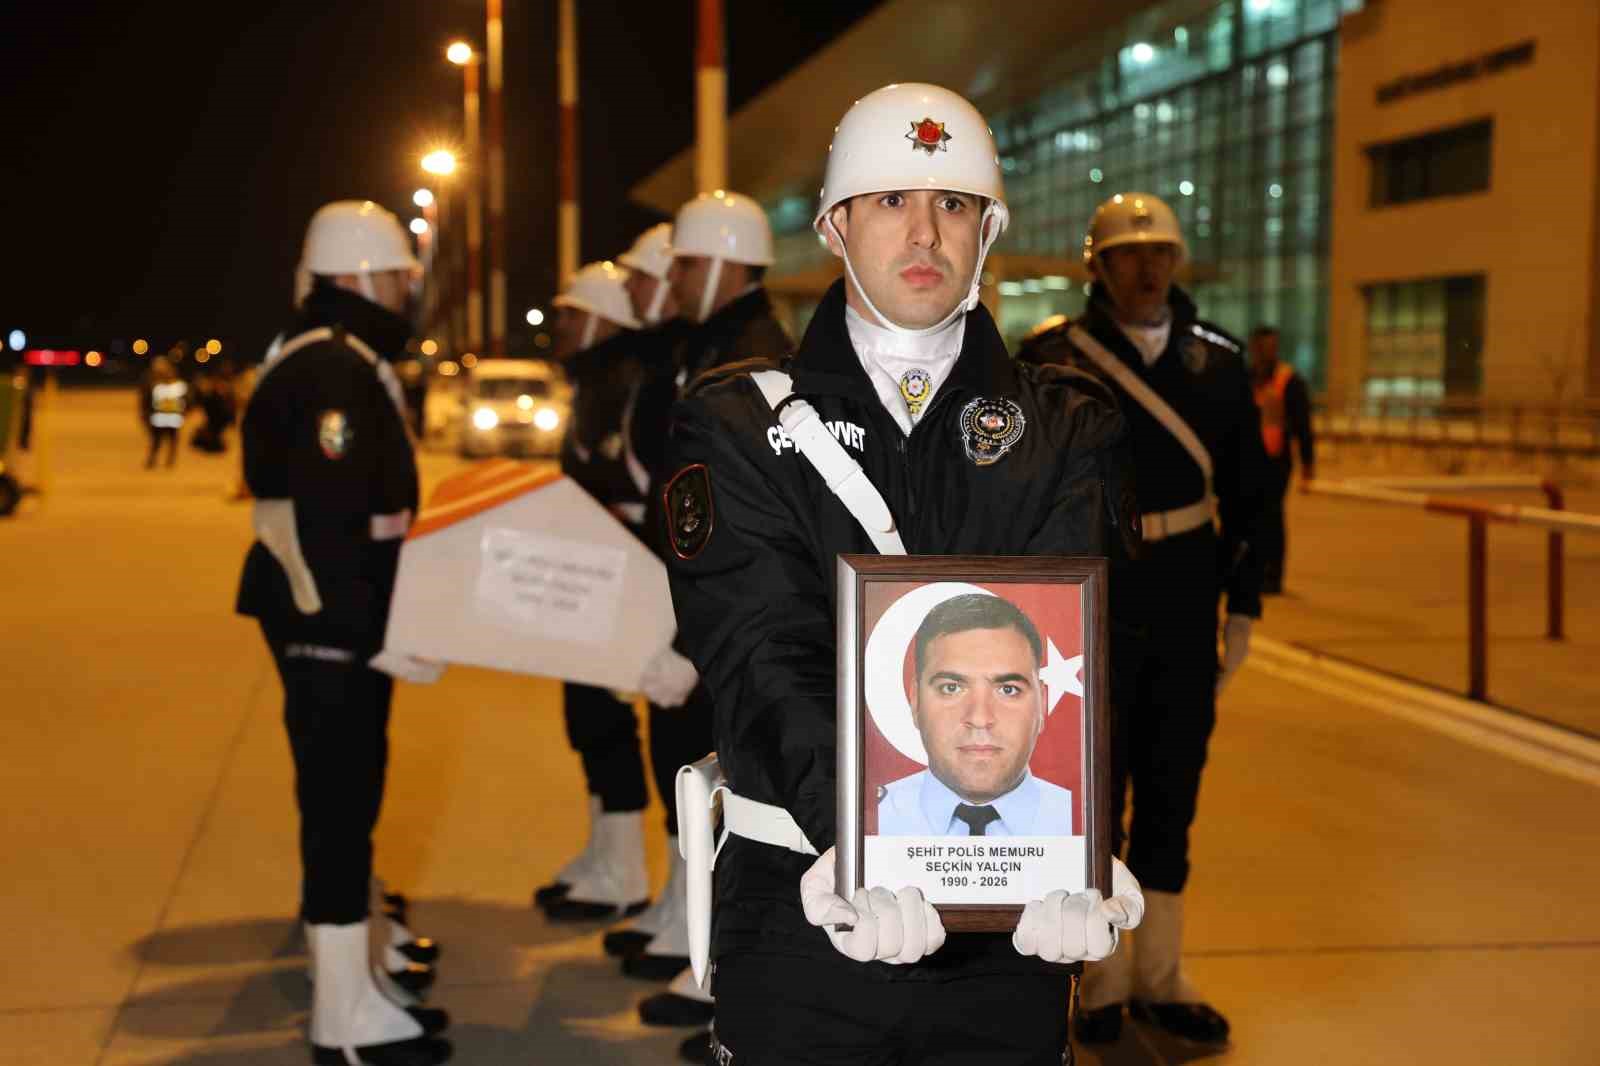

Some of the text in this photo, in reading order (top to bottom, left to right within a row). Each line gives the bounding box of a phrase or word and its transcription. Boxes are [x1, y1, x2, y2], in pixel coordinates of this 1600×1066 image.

[907, 844, 1045, 859] ŞEHİT POLİS MEMURU
[925, 859, 1022, 874] SEÇKİN YALÇIN
[941, 876, 968, 887] 1990
[980, 876, 1008, 887] 2026
